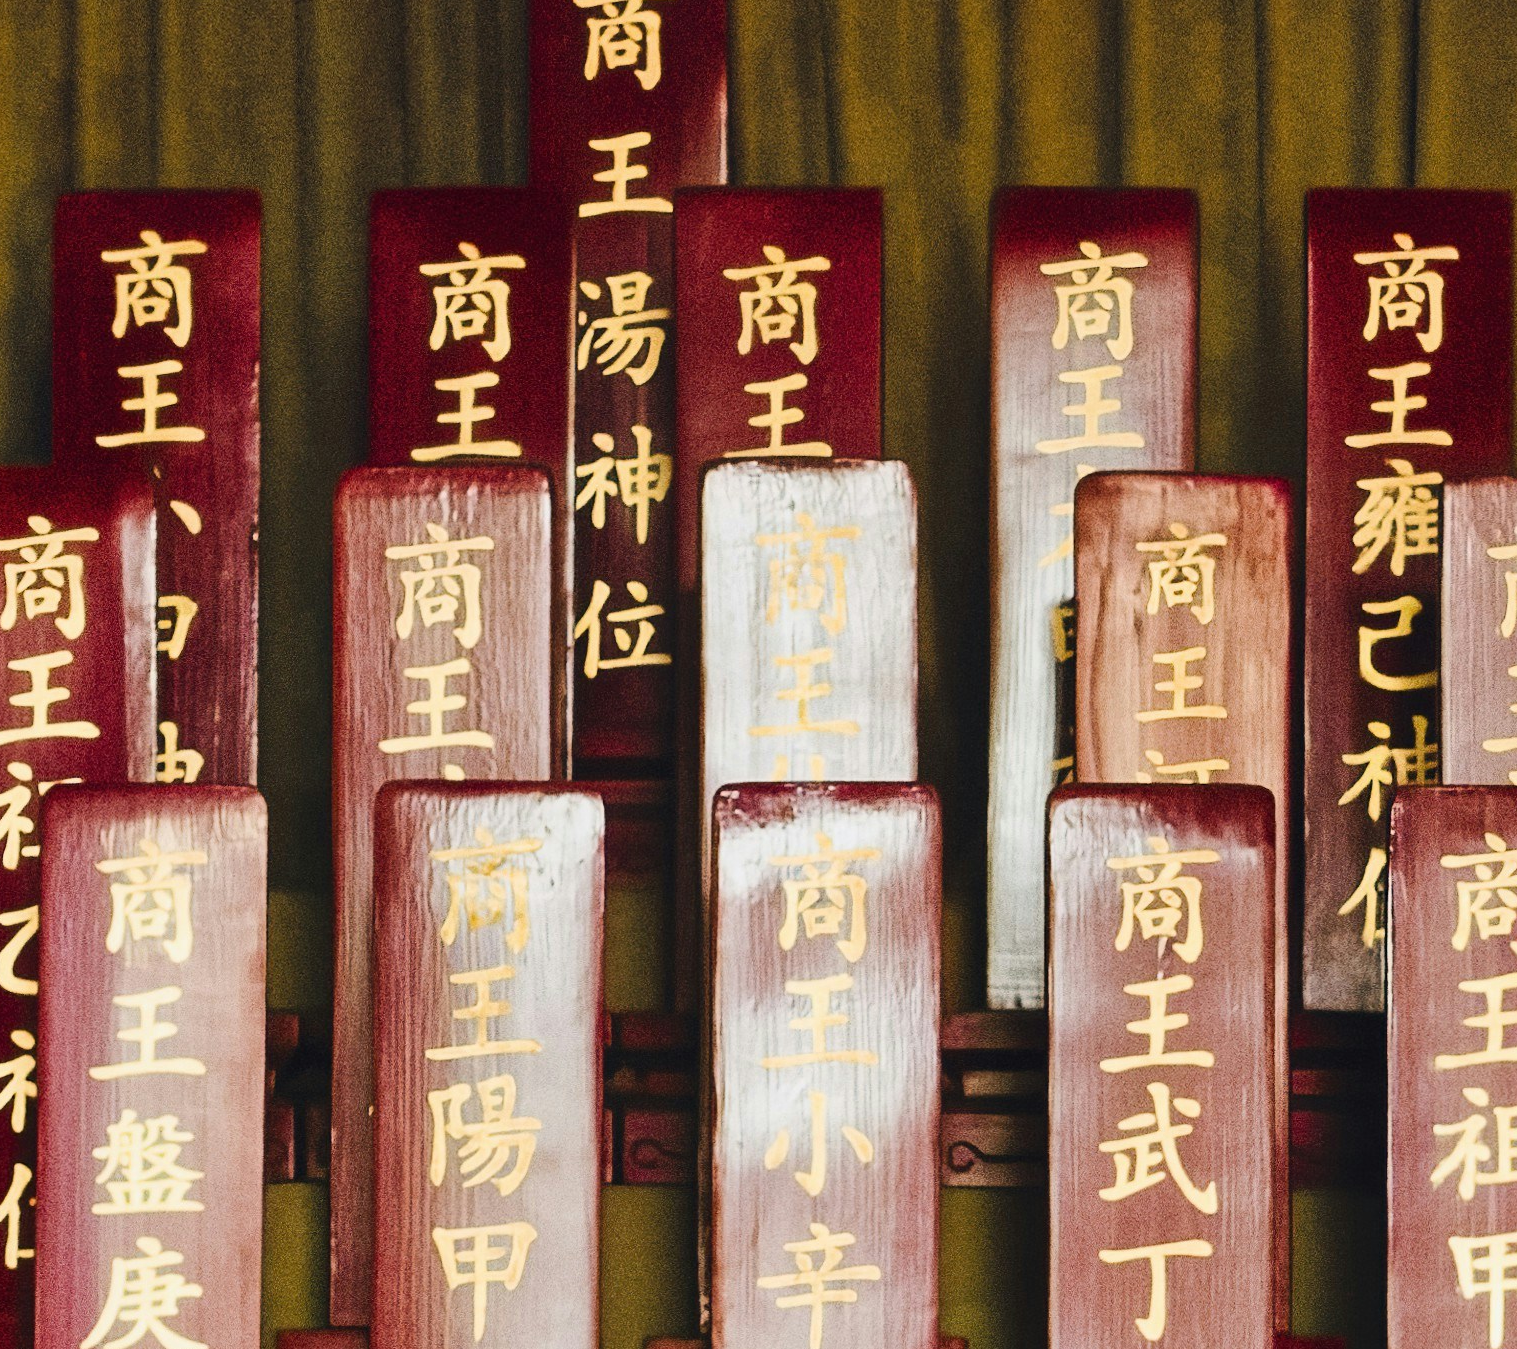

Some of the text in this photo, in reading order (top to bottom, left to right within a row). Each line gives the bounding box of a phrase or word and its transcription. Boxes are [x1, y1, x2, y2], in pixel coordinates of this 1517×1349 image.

[411, 241, 526, 460] 商王
[722, 245, 833, 458] 商王
[378, 523, 496, 780] 商王
[748, 513, 862, 783] 商王
